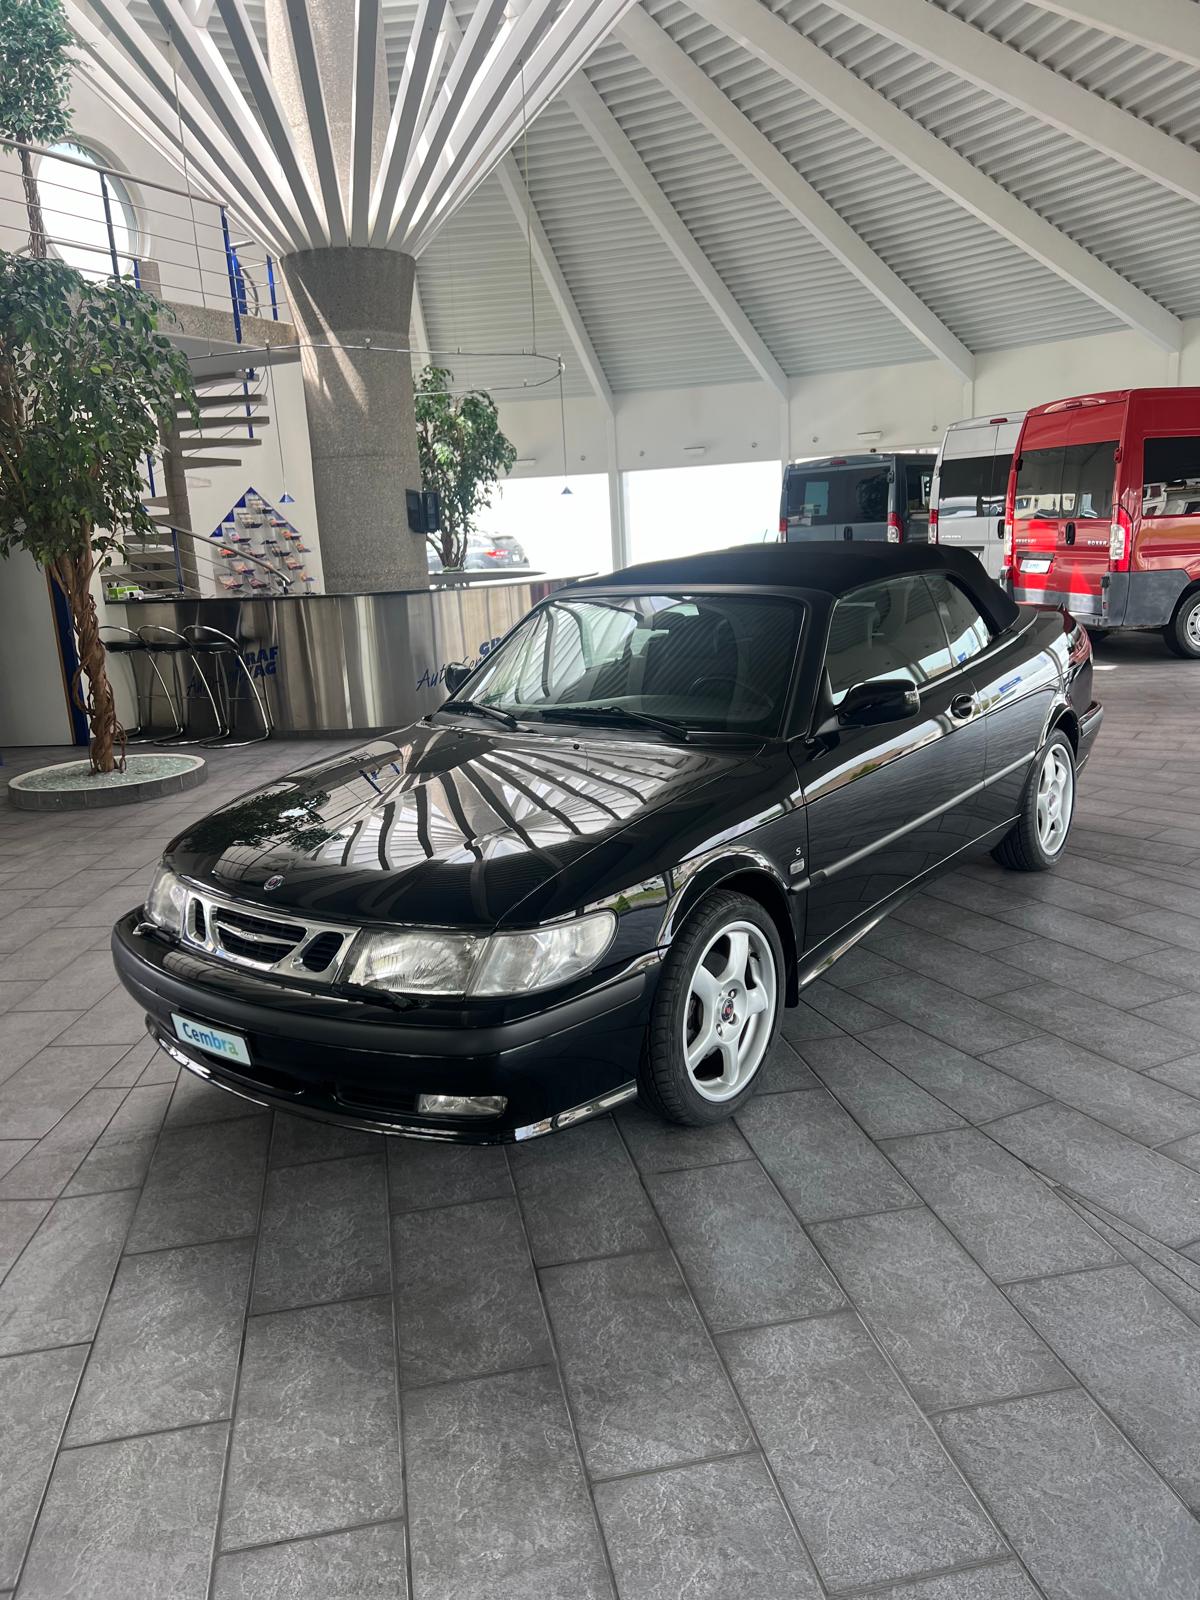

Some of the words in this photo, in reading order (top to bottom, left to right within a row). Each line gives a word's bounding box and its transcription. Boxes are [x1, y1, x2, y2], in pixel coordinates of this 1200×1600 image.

[416, 664, 446, 691] Aut
[795, 846, 802, 856] S
[182, 1022, 239, 1056] Cembra
